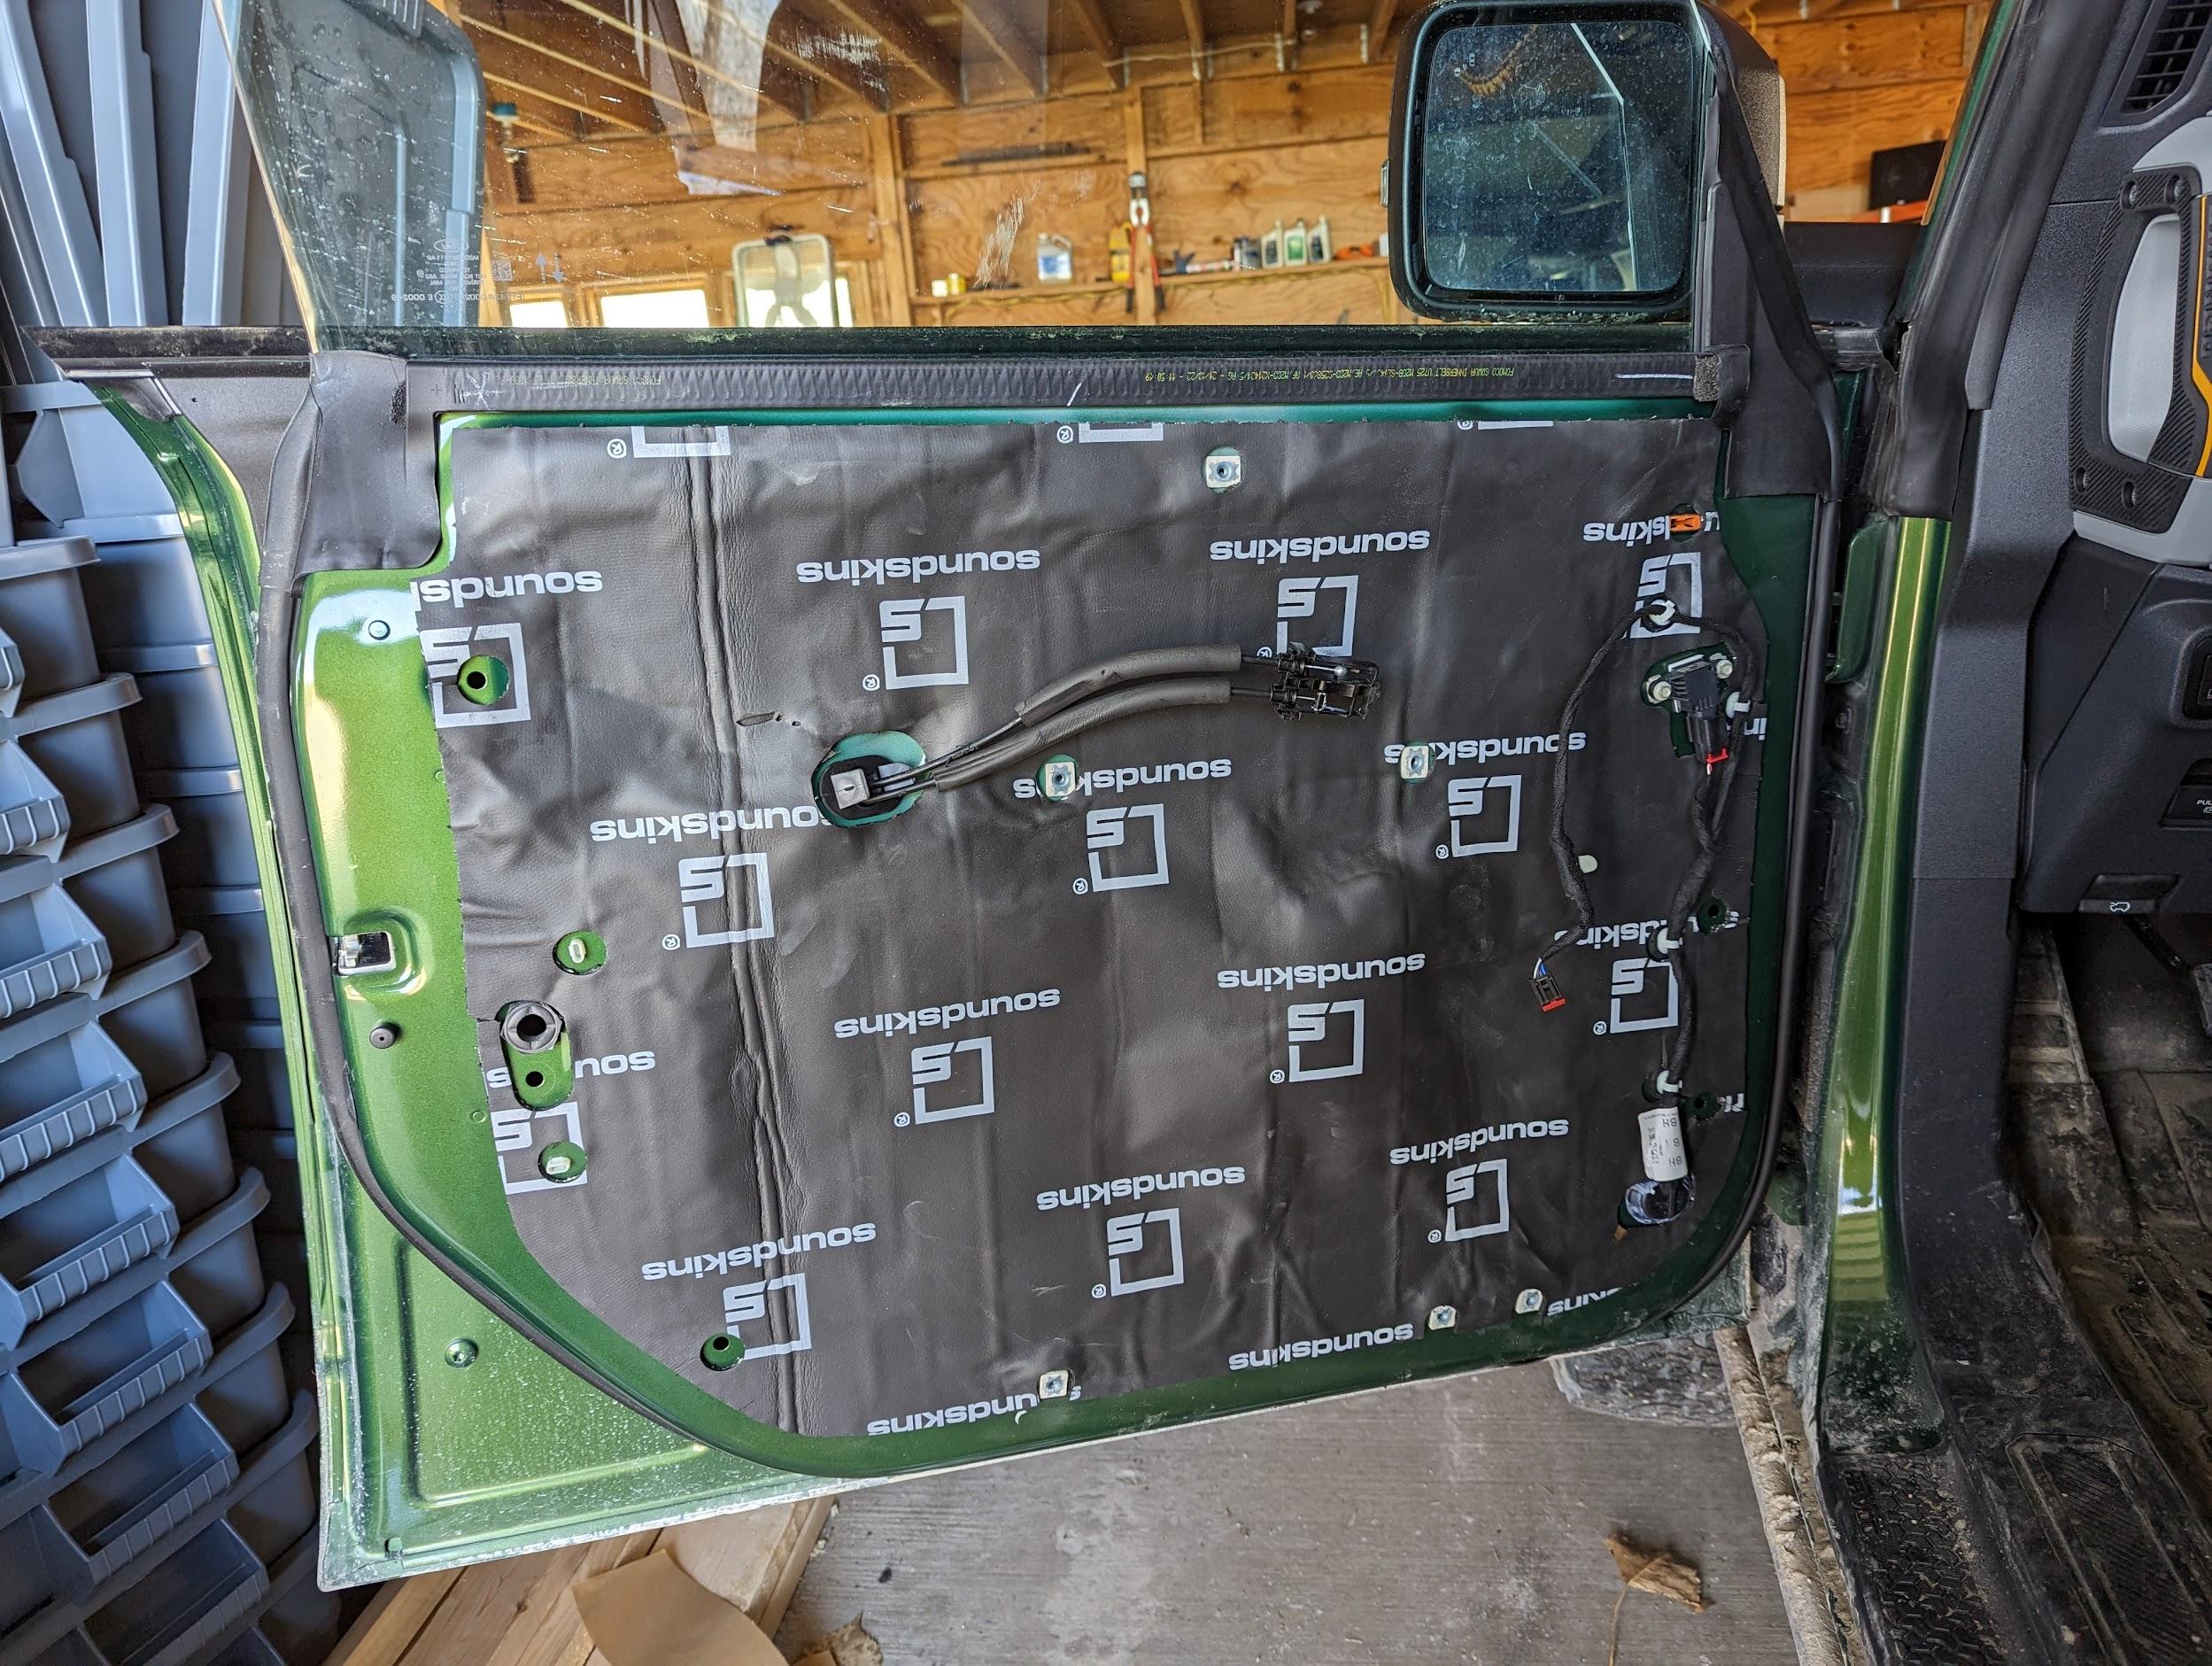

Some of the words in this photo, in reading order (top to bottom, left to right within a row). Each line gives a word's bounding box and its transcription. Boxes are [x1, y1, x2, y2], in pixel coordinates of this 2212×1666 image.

[795, 549, 1040, 586] soundskins
[1210, 530, 1431, 565] soundskins
[1217, 953, 1426, 992] soundskins
[833, 988, 1061, 1039] soundskins
[1390, 1119, 1569, 1166] soundskins
[1036, 1166, 1246, 1212] soundskins
[641, 1221, 878, 1282] soundskins
[1228, 1322, 1415, 1372] soundskins
